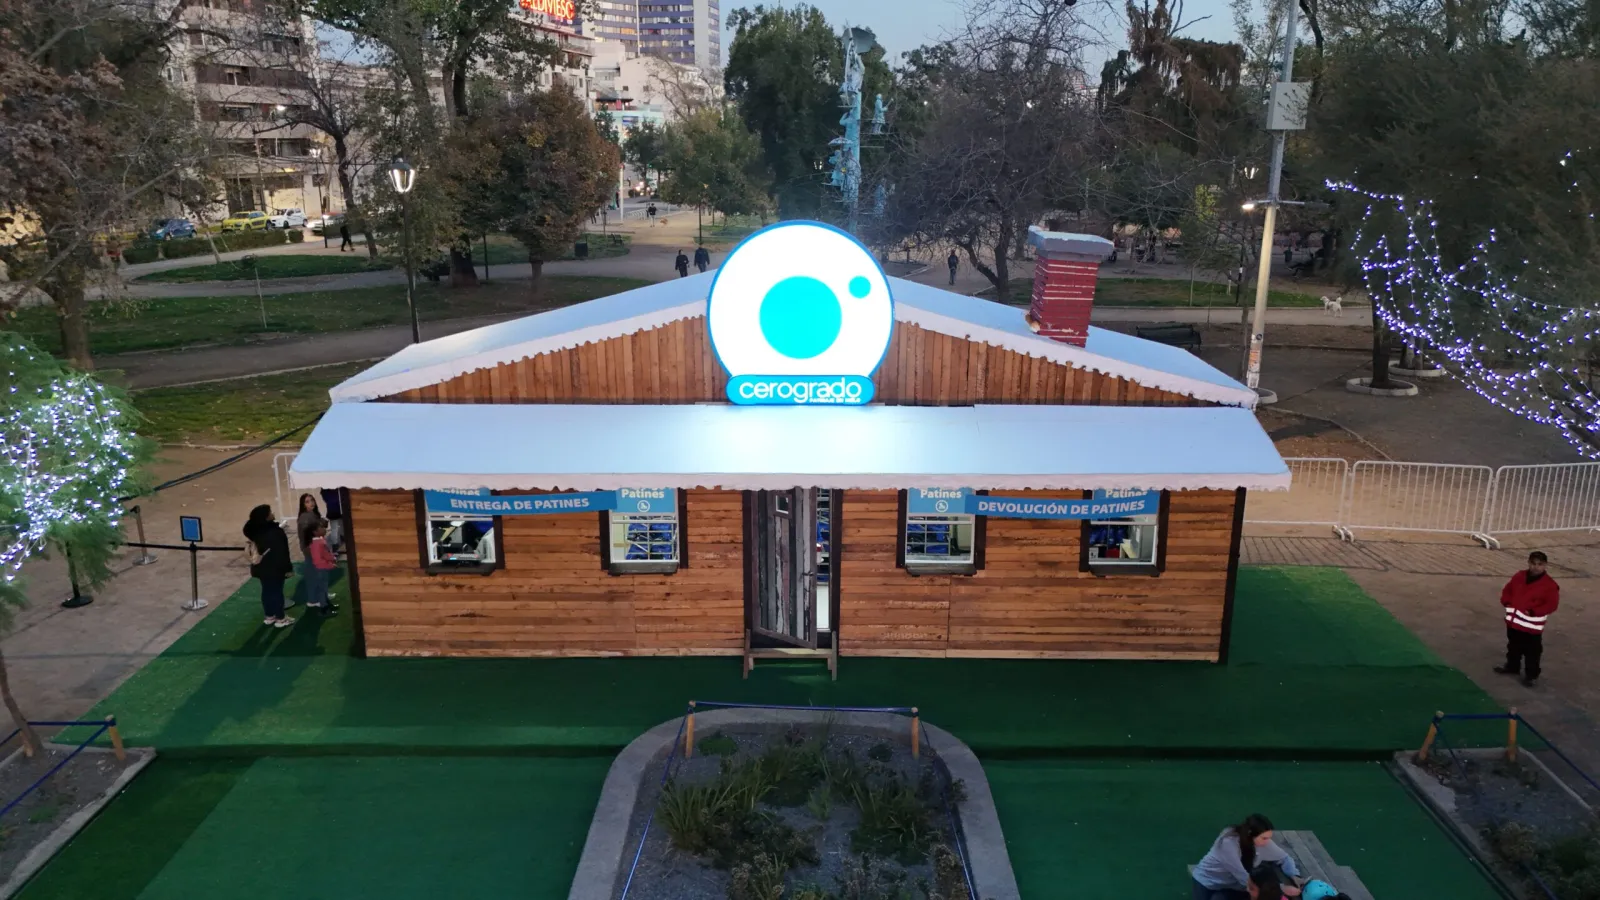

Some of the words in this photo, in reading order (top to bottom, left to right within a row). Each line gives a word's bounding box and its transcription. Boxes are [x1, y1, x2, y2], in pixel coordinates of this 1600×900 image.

[739, 377, 861, 403] cerogrado
[621, 488, 665, 499] Patines
[920, 489, 962, 499] Patines
[450, 498, 512, 511] ENTREGA
[513, 500, 533, 511] DE
[534, 497, 590, 510] PATINES
[978, 501, 1068, 515] DEVOLUCIÓN
[1070, 504, 1089, 515] DE
[1091, 499, 1146, 514] PATINES
